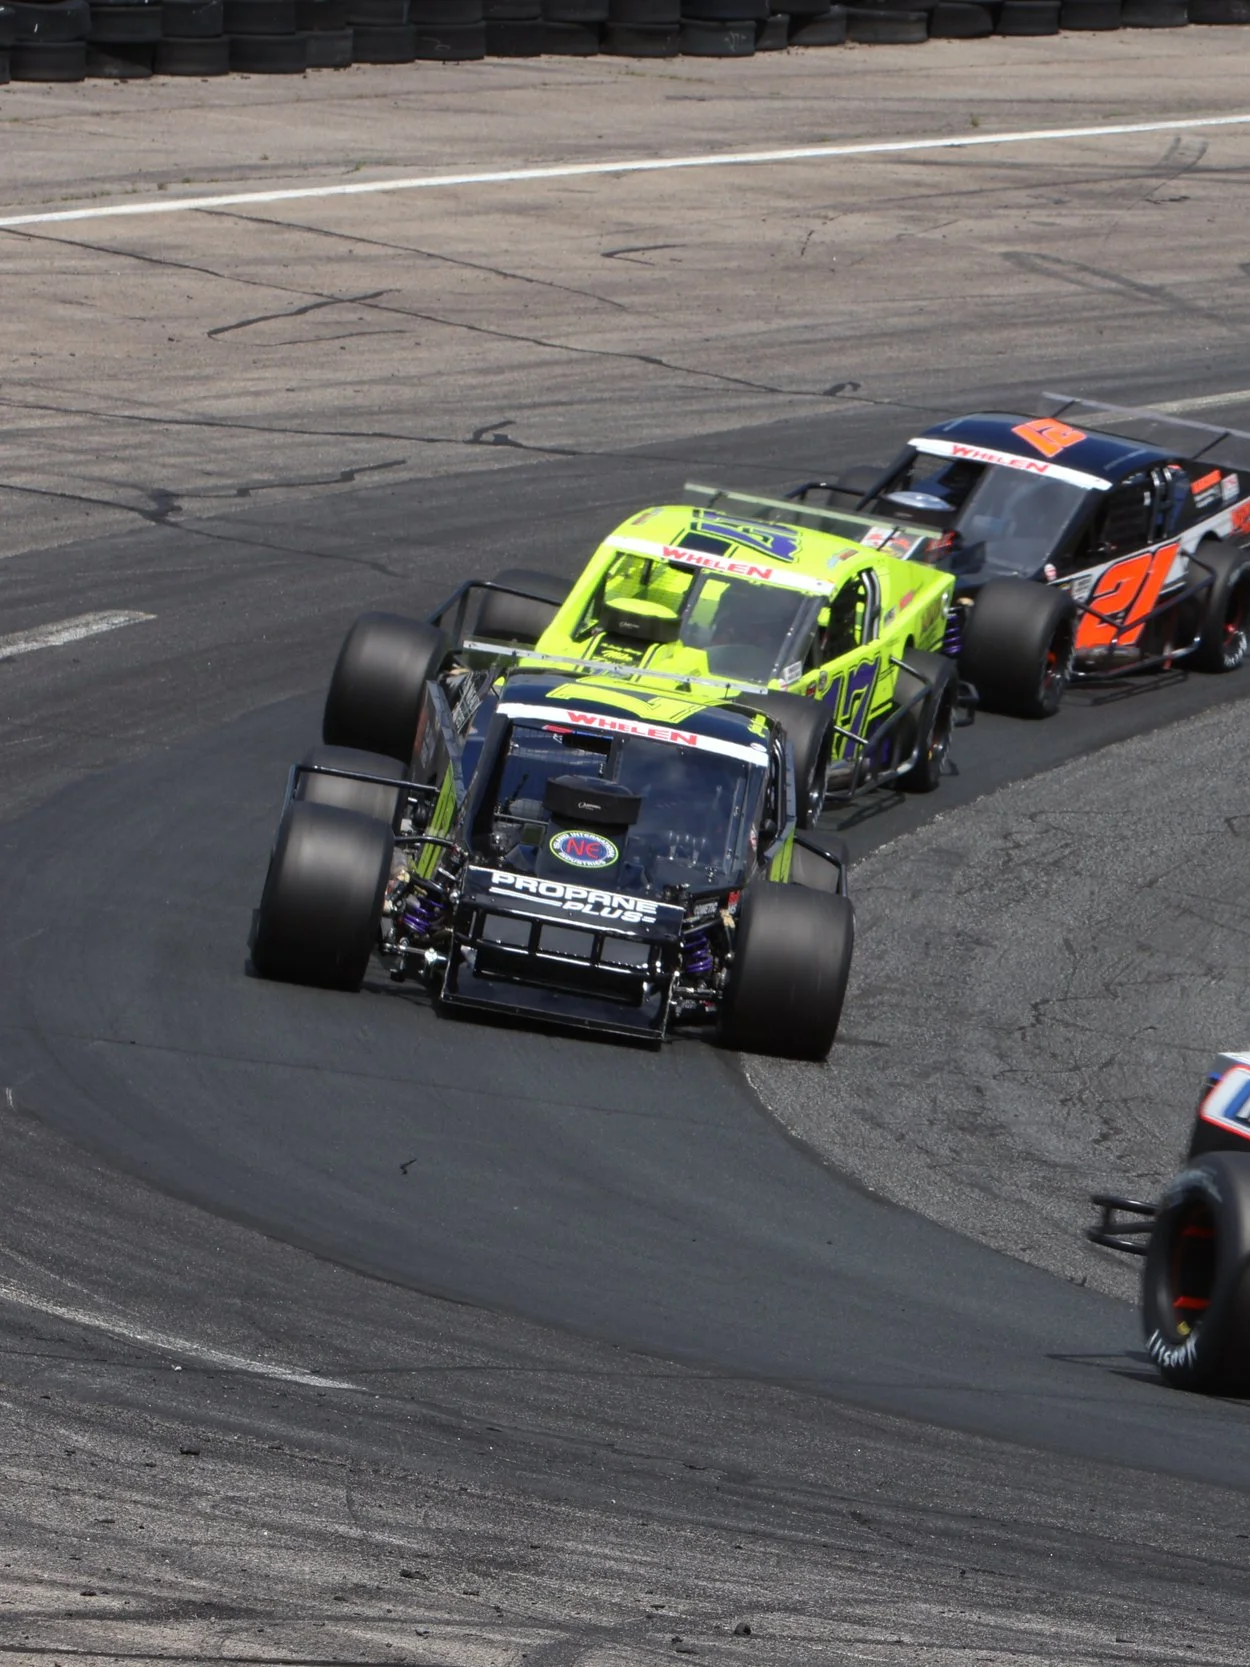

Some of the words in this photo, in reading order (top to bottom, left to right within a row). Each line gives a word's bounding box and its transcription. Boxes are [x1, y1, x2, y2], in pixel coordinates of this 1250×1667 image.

[952, 444, 1051, 473] WHELEN
[663, 545, 774, 580] WHELEN
[1074, 541, 1181, 650] 21
[567, 710, 698, 746] WHELEN
[566, 837, 601, 859] NE
[491, 871, 660, 915] PROPANE
[562, 901, 643, 923] PLUS
